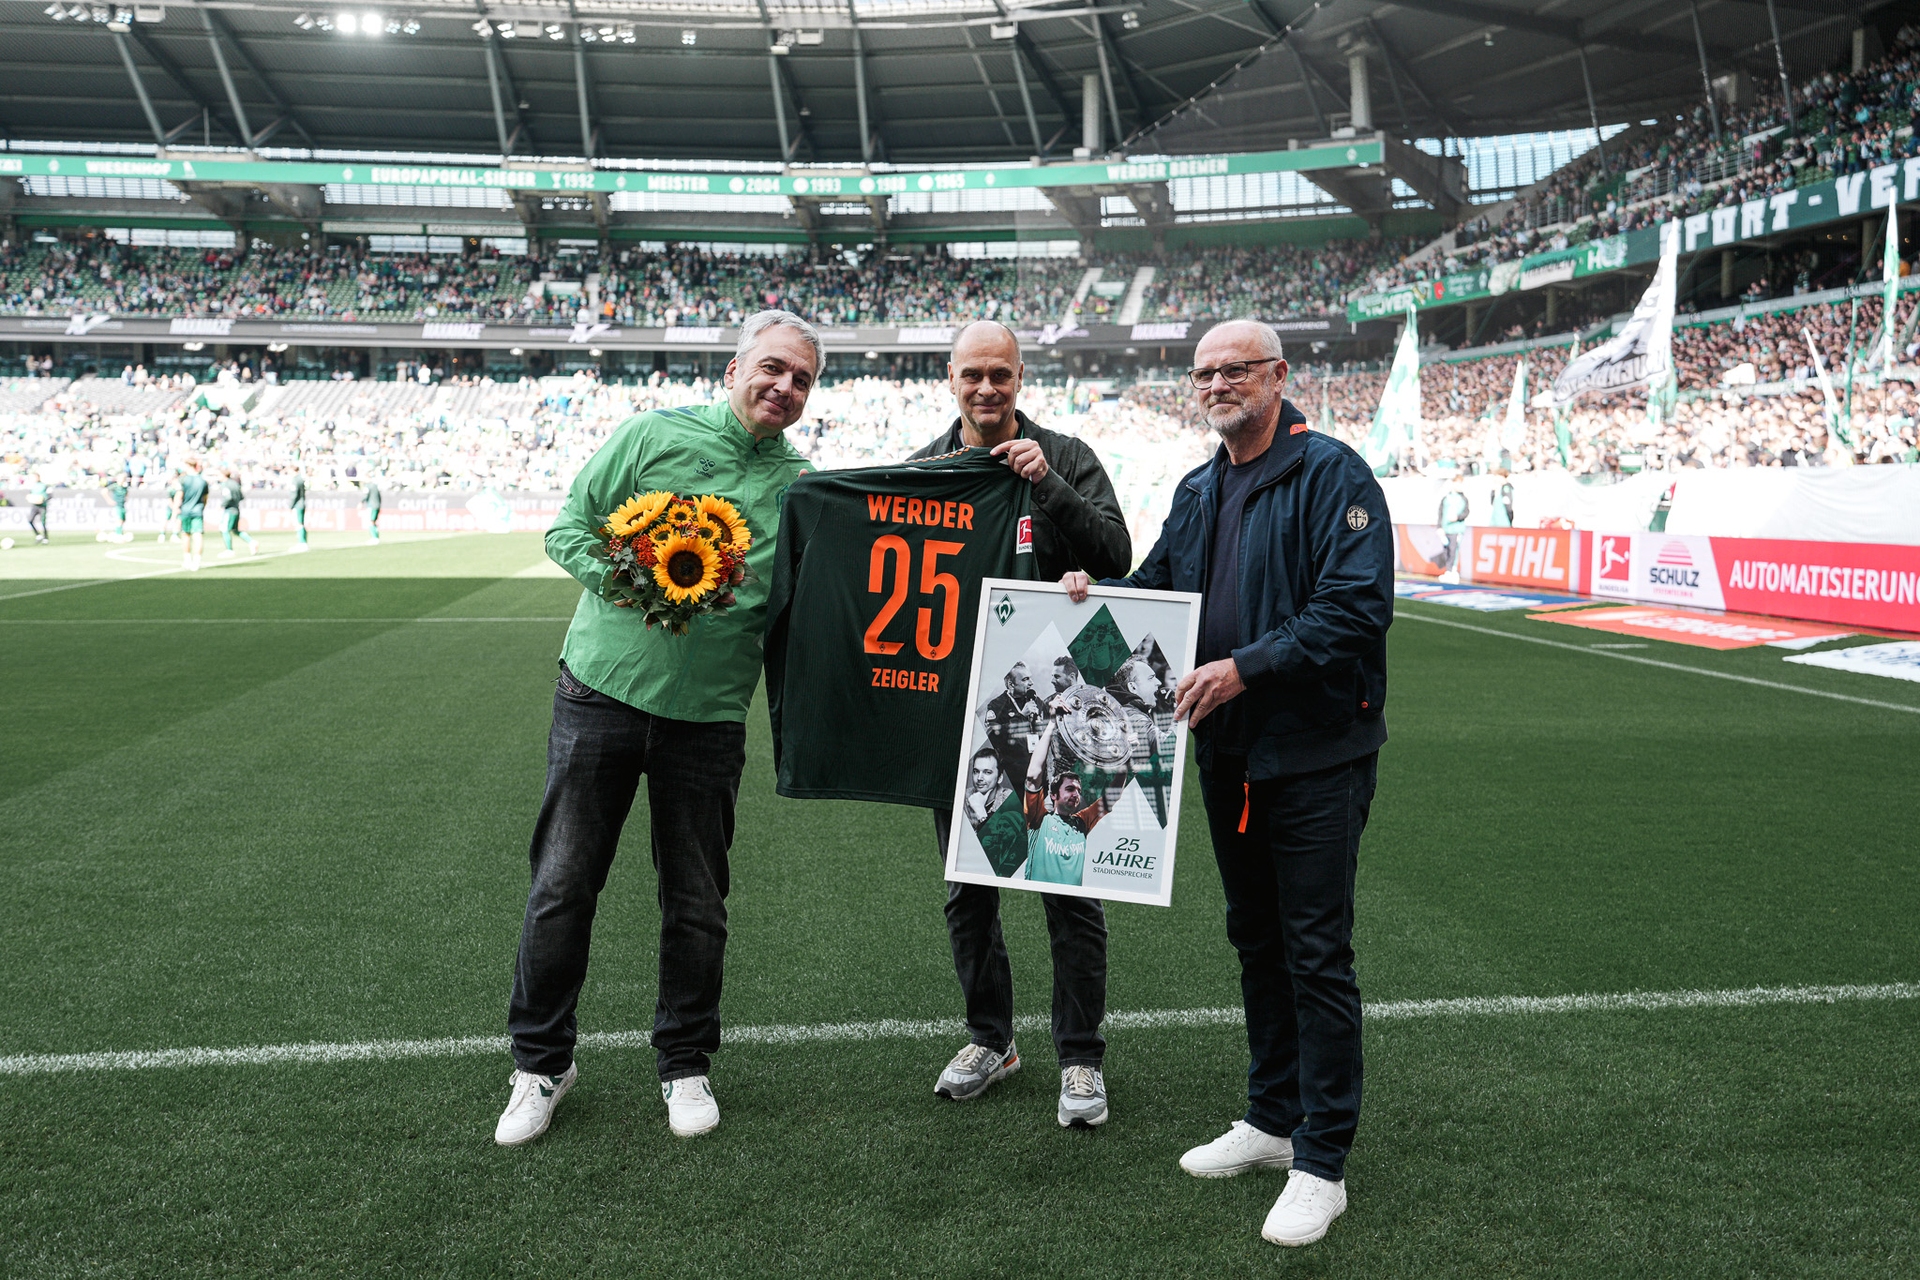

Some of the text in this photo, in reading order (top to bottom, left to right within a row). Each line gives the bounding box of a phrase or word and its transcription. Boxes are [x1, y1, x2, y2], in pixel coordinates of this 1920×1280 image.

[85, 161, 172, 175] WIESENHOF
[371, 167, 536, 187] EUROPAPOKAL-SIEGER
[1107, 157, 1229, 180] WERDER BREMEN
[648, 174, 710, 192] MEISTER
[0, 508, 162, 525] POER BY SIHL
[263, 510, 334, 529] STHL
[867, 494, 975, 531] WERDER
[1475, 533, 1565, 580] STIHL
[1650, 567, 1700, 588] SCHULZ
[1729, 559, 1920, 605] AUTOMATISIERUN
[863, 534, 966, 661] 25
[871, 667, 940, 693] ZEIGLER
[1115, 837, 1140, 852] 25
[1092, 851, 1157, 870] JAHRE
[1093, 867, 1153, 879] STADIONSPRECHER
